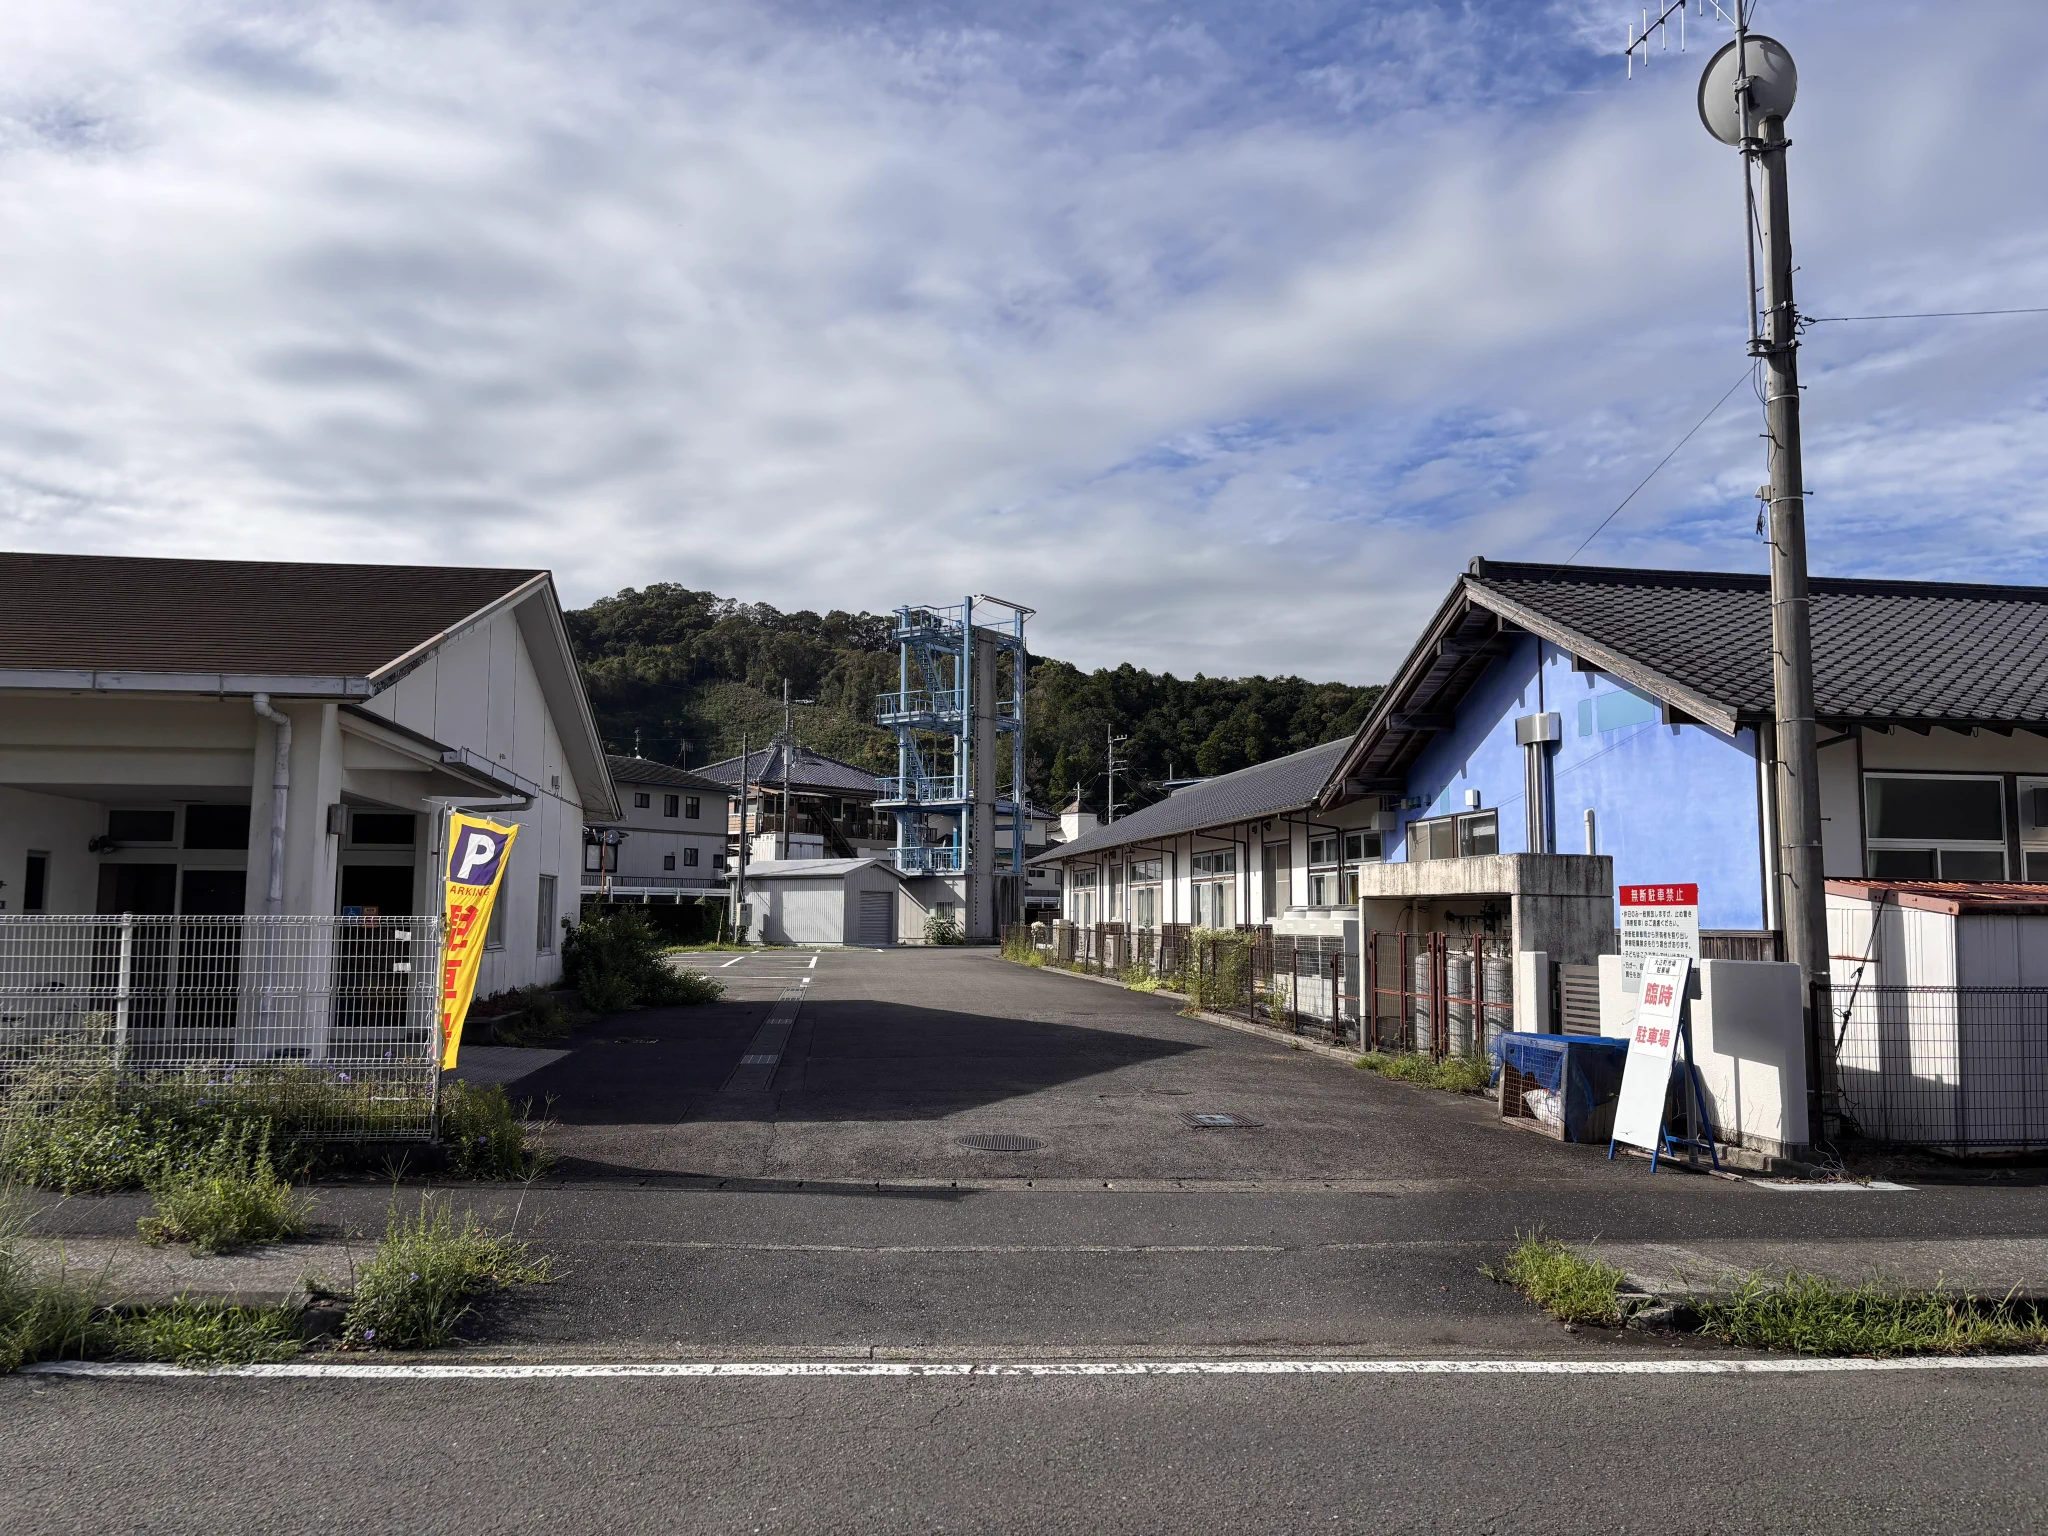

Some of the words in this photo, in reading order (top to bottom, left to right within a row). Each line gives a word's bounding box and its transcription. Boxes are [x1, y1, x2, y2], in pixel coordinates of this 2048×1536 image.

[456, 833, 496, 879] P
[450, 885, 491, 897] ARKING
[1630, 888, 1684, 902] 無断駐車禁止
[1644, 982, 1674, 1007] 臨時
[1634, 1024, 1671, 1048] 駐車場
